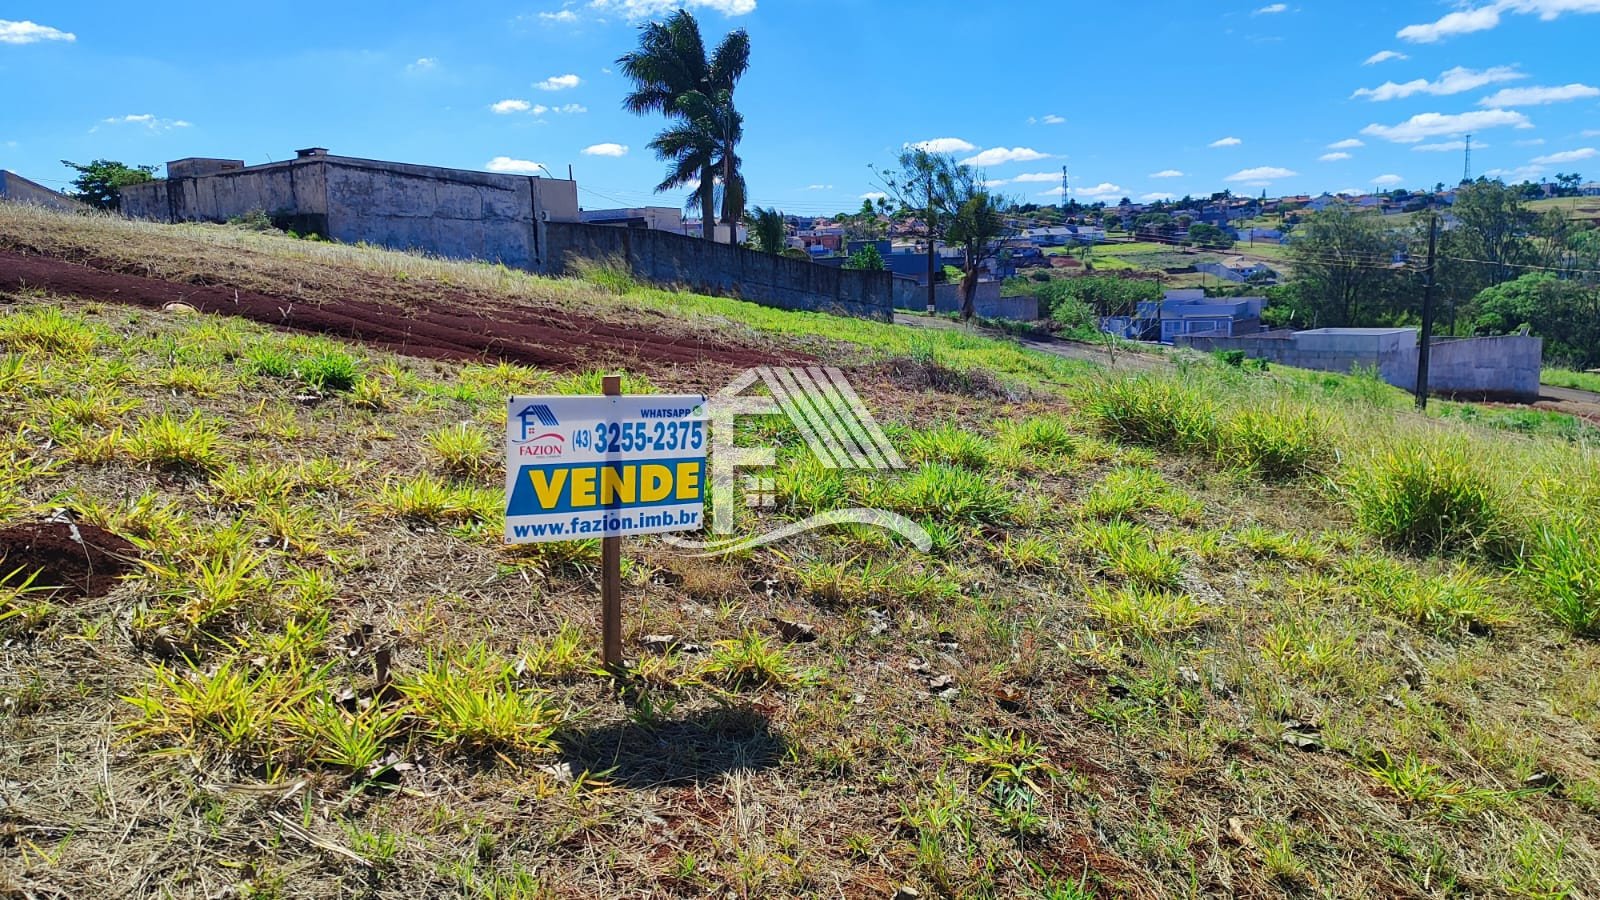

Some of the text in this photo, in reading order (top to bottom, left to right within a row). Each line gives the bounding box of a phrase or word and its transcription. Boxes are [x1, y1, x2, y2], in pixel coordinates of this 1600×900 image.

[640, 408, 691, 419] WHATSAPP
[519, 445, 562, 456] FAZION
[572, 421, 703, 453] (43) 3255-2375
[528, 462, 700, 509] VENDE
[513, 511, 699, 538] www.fazion.imb.br
